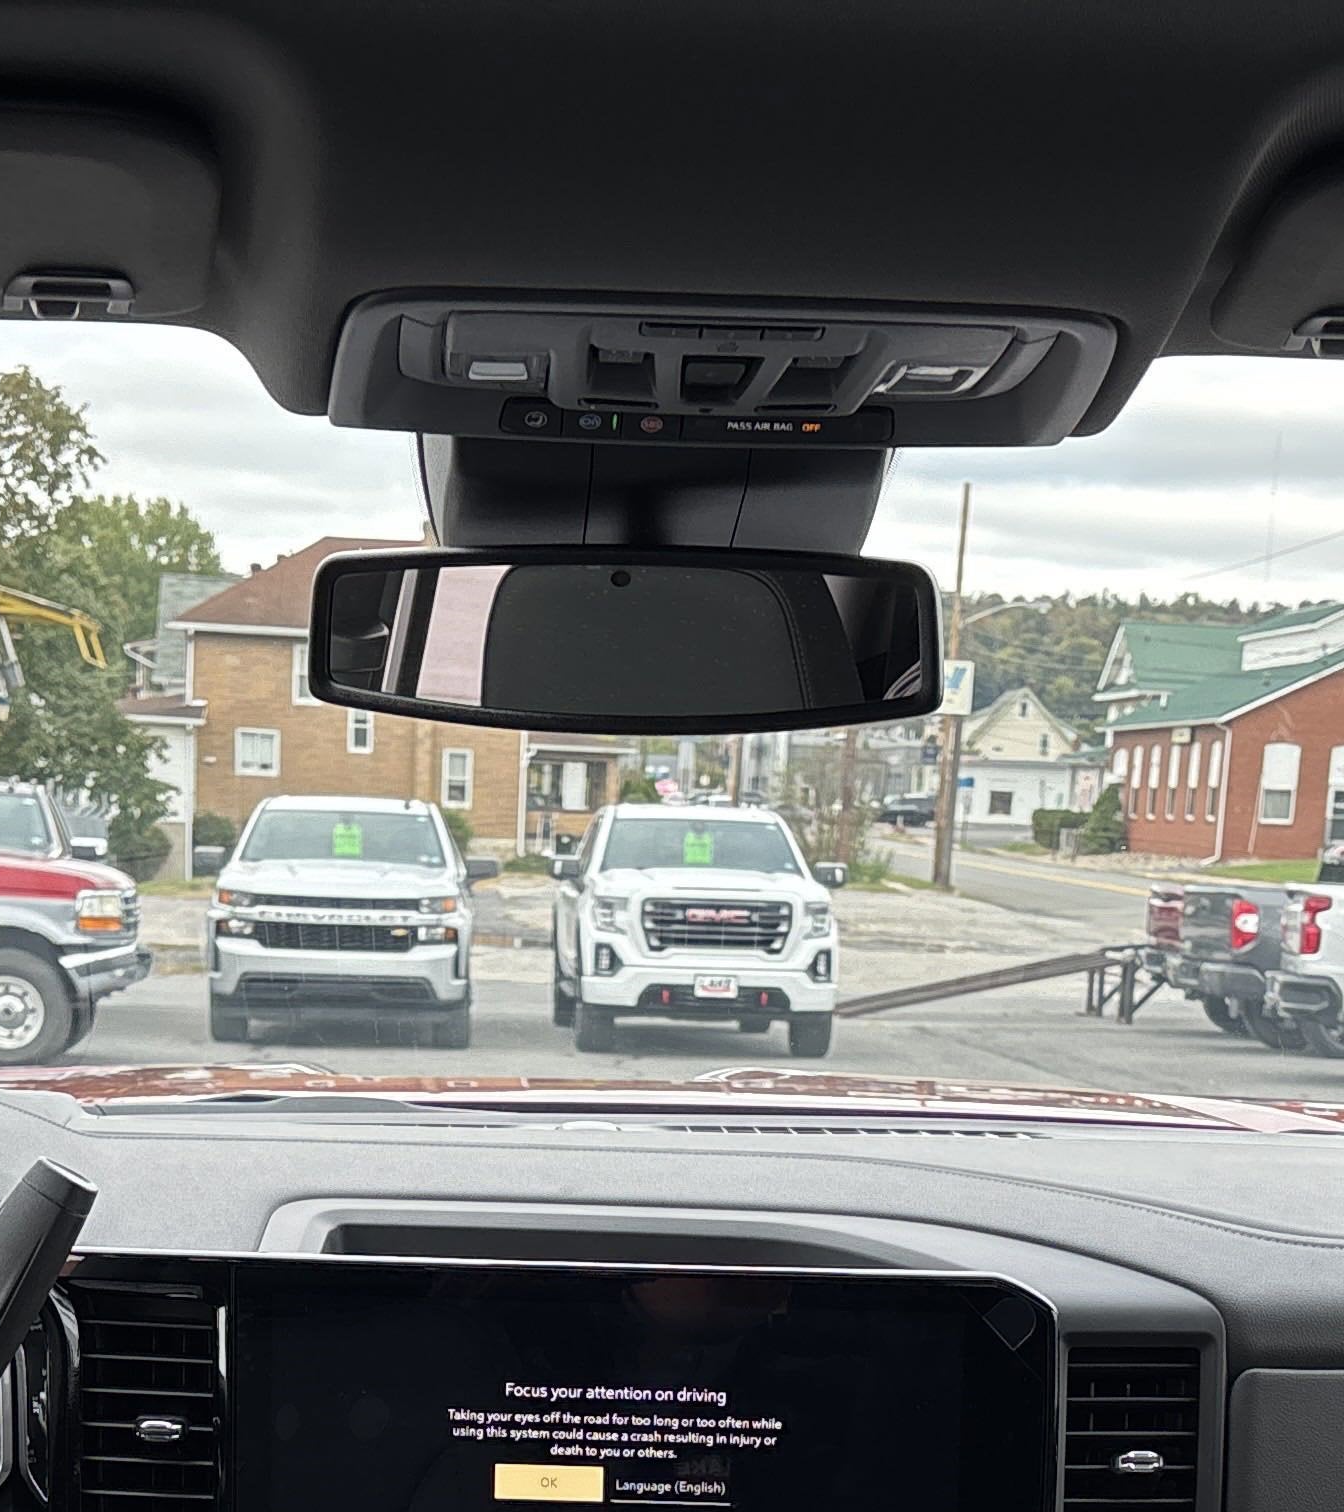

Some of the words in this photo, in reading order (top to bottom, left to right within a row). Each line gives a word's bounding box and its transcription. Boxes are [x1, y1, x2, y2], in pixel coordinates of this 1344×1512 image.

[726, 421, 753, 431] PASS
[754, 422, 772, 432] AIR
[773, 422, 794, 432] BAG
[801, 423, 822, 433] OFF
[686, 907, 751, 925] GMC
[505, 1382, 548, 1398] Focus
[550, 1387, 583, 1402] your
[585, 1385, 652, 1401] attention
[654, 1388, 674, 1401] on
[676, 1386, 727, 1407] driving
[447, 1408, 485, 1424] Taking
[486, 1411, 513, 1425] your
[514, 1412, 541, 1426] eyes
[542, 1410, 560, 1424] off
[562, 1411, 582, 1425] the
[583, 1412, 610, 1425] road
[611, 1412, 629, 1426] for
[631, 1414, 652, 1427] too
[653, 1414, 679, 1430] long
[681, 1417, 694, 1428] or
[696, 1416, 716, 1428] too
[718, 1416, 750, 1430] often
[752, 1417, 783, 1431] while
[452, 1426, 484, 1440] using
[486, 1426, 507, 1438] this
[509, 1428, 550, 1442] system
[552, 1428, 584, 1441] could
[586, 1432, 619, 1442] cause
[620, 1432, 629, 1442] a
[630, 1430, 662, 1443] crash
[663, 1431, 714, 1447] resulting
[716, 1433, 727, 1445] in
[729, 1432, 762, 1449] injury
[763, 1437, 778, 1446] or
[550, 1443, 584, 1457] death
[585, 1444, 598, 1457] to
[599, 1447, 620, 1460] you
[622, 1447, 636, 1458] or
[637, 1446, 678, 1459] others.
[540, 1476, 559, 1489] OK
[615, 1479, 672, 1495] Language
[674, 1480, 726, 1496] (English)
